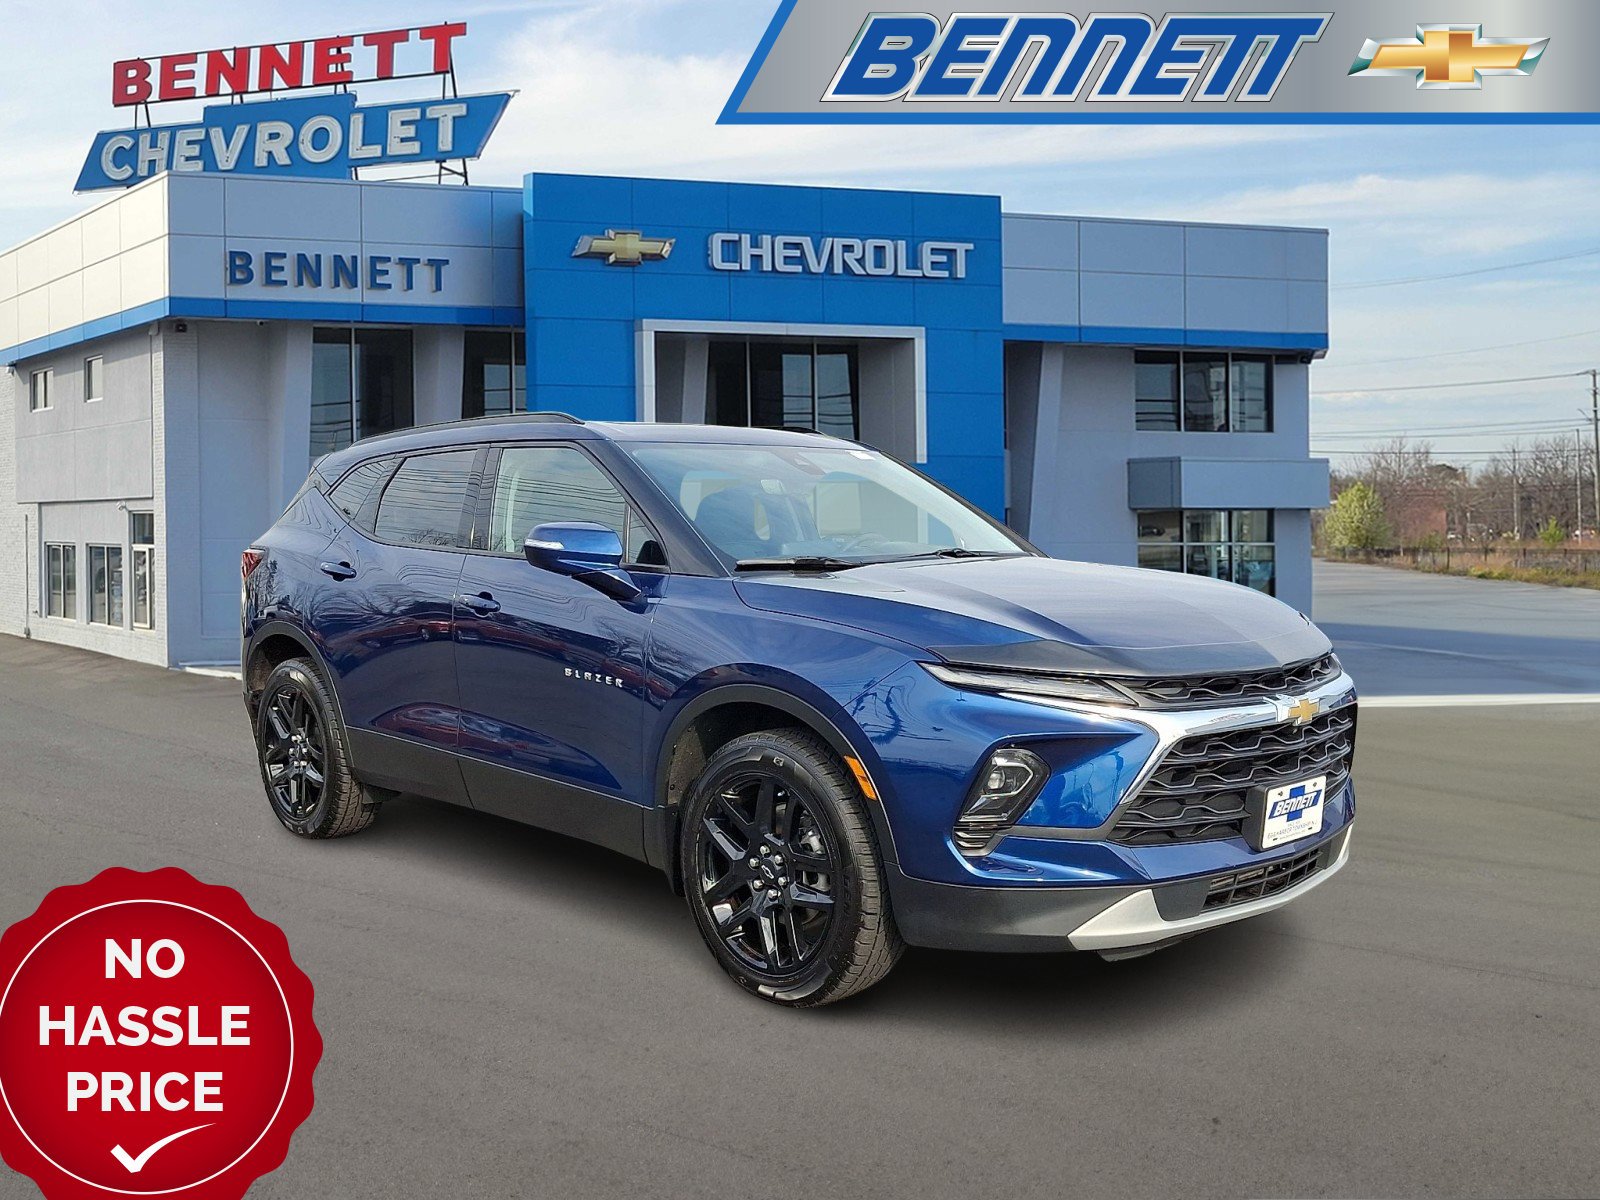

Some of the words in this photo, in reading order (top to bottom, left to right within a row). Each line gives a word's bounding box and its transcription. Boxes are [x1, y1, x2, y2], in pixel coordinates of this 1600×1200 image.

[112, 22, 467, 107] BENNETT
[100, 103, 469, 181] CHEVROLET
[226, 249, 450, 292] BENNETT
[708, 232, 975, 280] CHEVROLET
[564, 667, 623, 687] BLAZER
[1274, 792, 1317, 816] BENNETT
